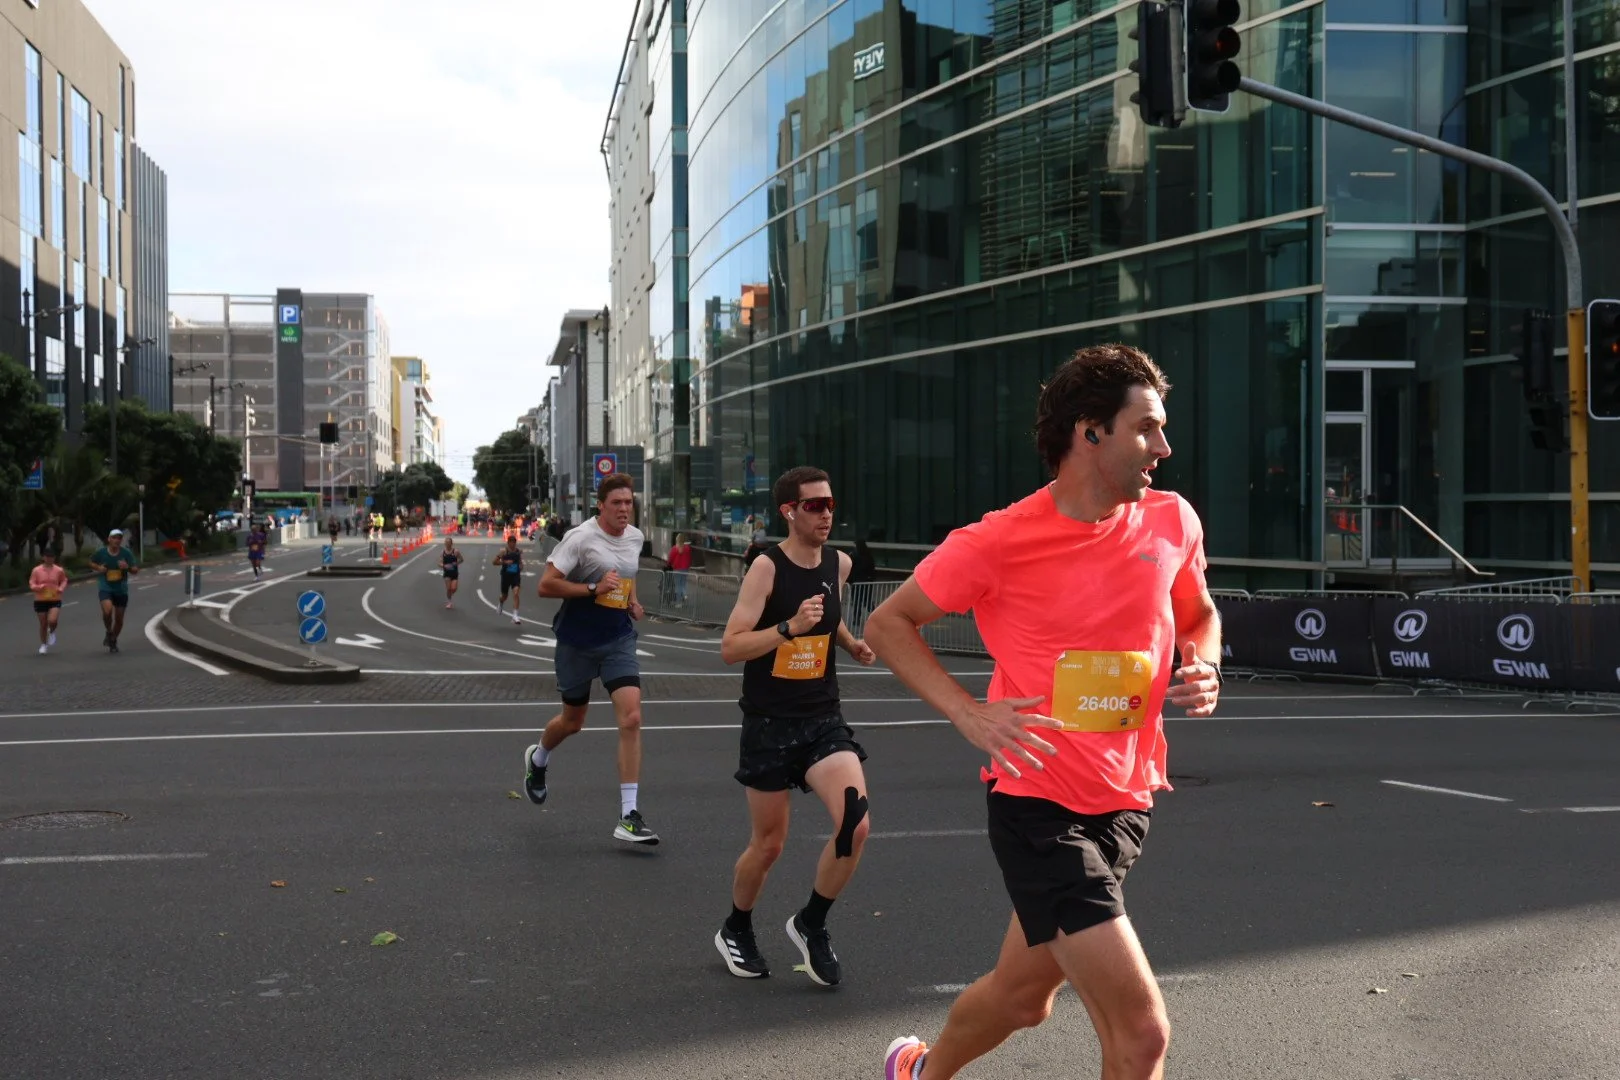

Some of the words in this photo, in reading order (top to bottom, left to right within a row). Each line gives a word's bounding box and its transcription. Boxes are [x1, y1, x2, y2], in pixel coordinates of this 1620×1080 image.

[283, 307, 295, 321] P
[1289, 647, 1338, 663] GWM
[1390, 651, 1430, 668] GWM
[788, 661, 815, 669] 23091
[1492, 659, 1550, 679] GWM
[1078, 695, 1129, 711] 26406
